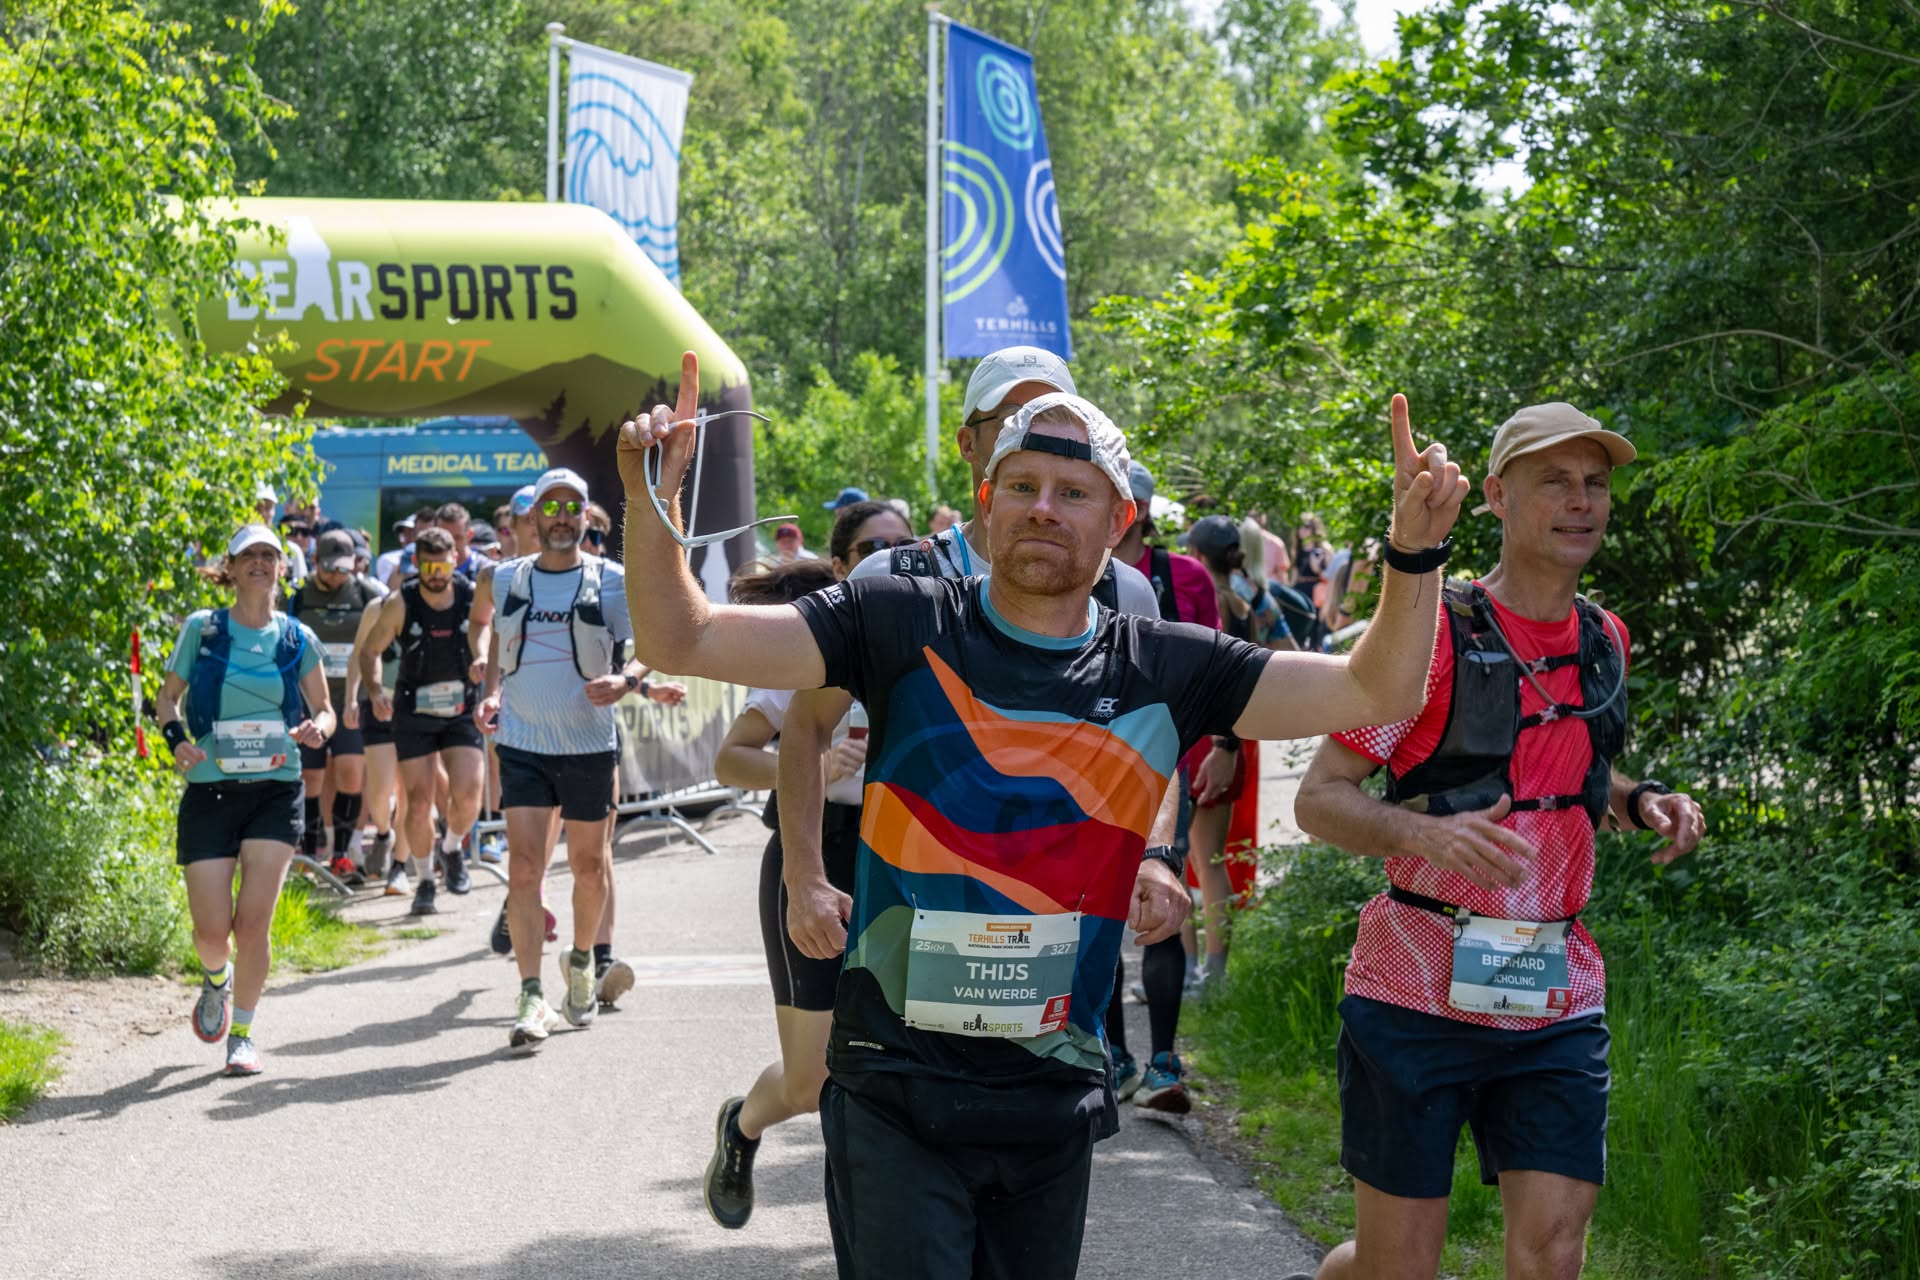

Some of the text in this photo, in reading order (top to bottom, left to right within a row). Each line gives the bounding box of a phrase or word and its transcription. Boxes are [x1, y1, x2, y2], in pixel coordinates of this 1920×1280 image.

[305, 338, 492, 382] START
[387, 454, 488, 474] MEDICAL
[233, 739, 265, 749] JOYCE
[968, 930, 1030, 945] TERHILLS TRAIL
[1050, 944, 1071, 955] 327
[966, 962, 1029, 981] THIJS
[954, 986, 1038, 1000] VAN WERDE
[963, 1014, 1023, 1032] BEARSPORTS
